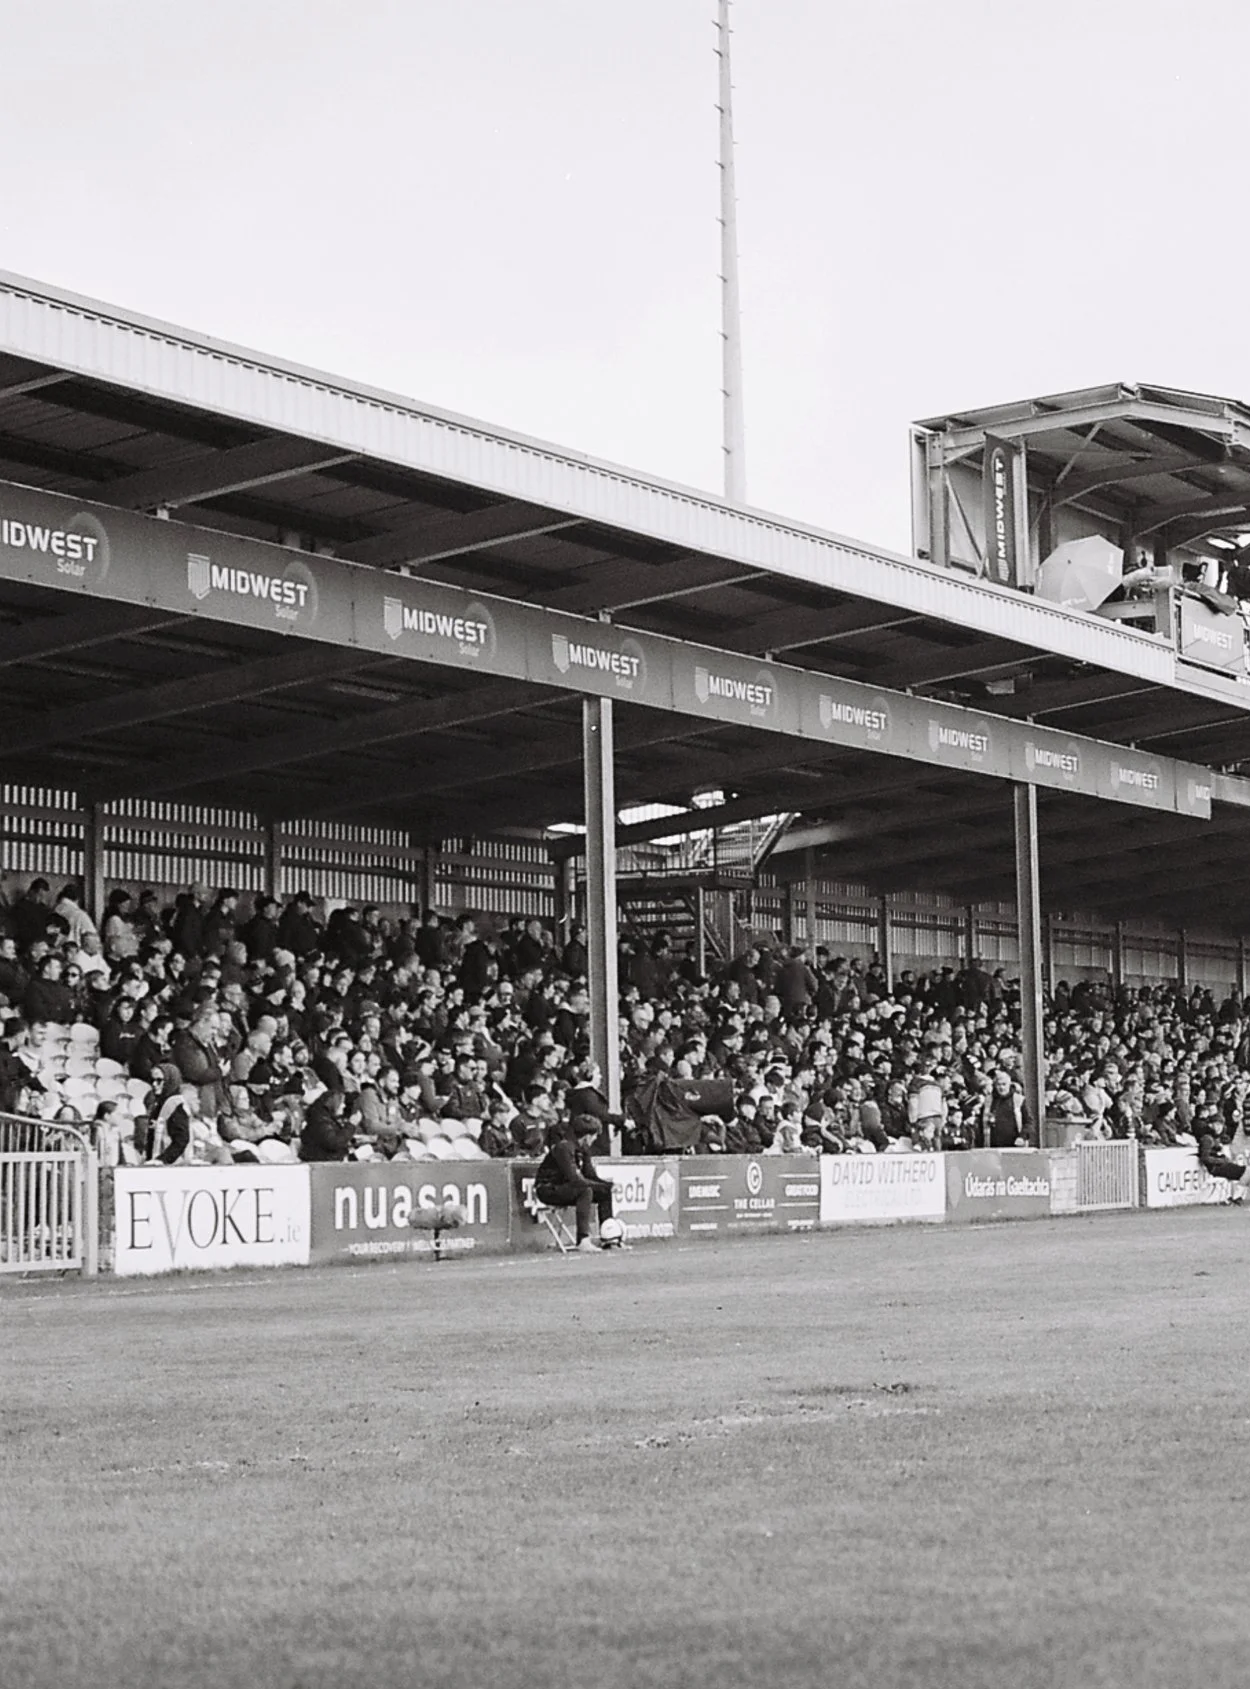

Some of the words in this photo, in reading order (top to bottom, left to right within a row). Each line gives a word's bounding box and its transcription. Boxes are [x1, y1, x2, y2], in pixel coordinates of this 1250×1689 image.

[56, 558, 85, 577] Solar
[211, 565, 308, 607] MIDWEST
[403, 606, 488, 645] MIDWEST
[569, 643, 639, 676] MIDWEST
[709, 675, 772, 706] MIDWEST
[831, 703, 887, 730] MIDWEST
[939, 727, 988, 752] MIDWEST
[1035, 748, 1079, 772] MIDWEST
[832, 1161, 873, 1186] DAVID
[877, 1159, 937, 1184] WITHERO
[733, 1198, 747, 1210] THE
[749, 1198, 775, 1210] CELLAR
